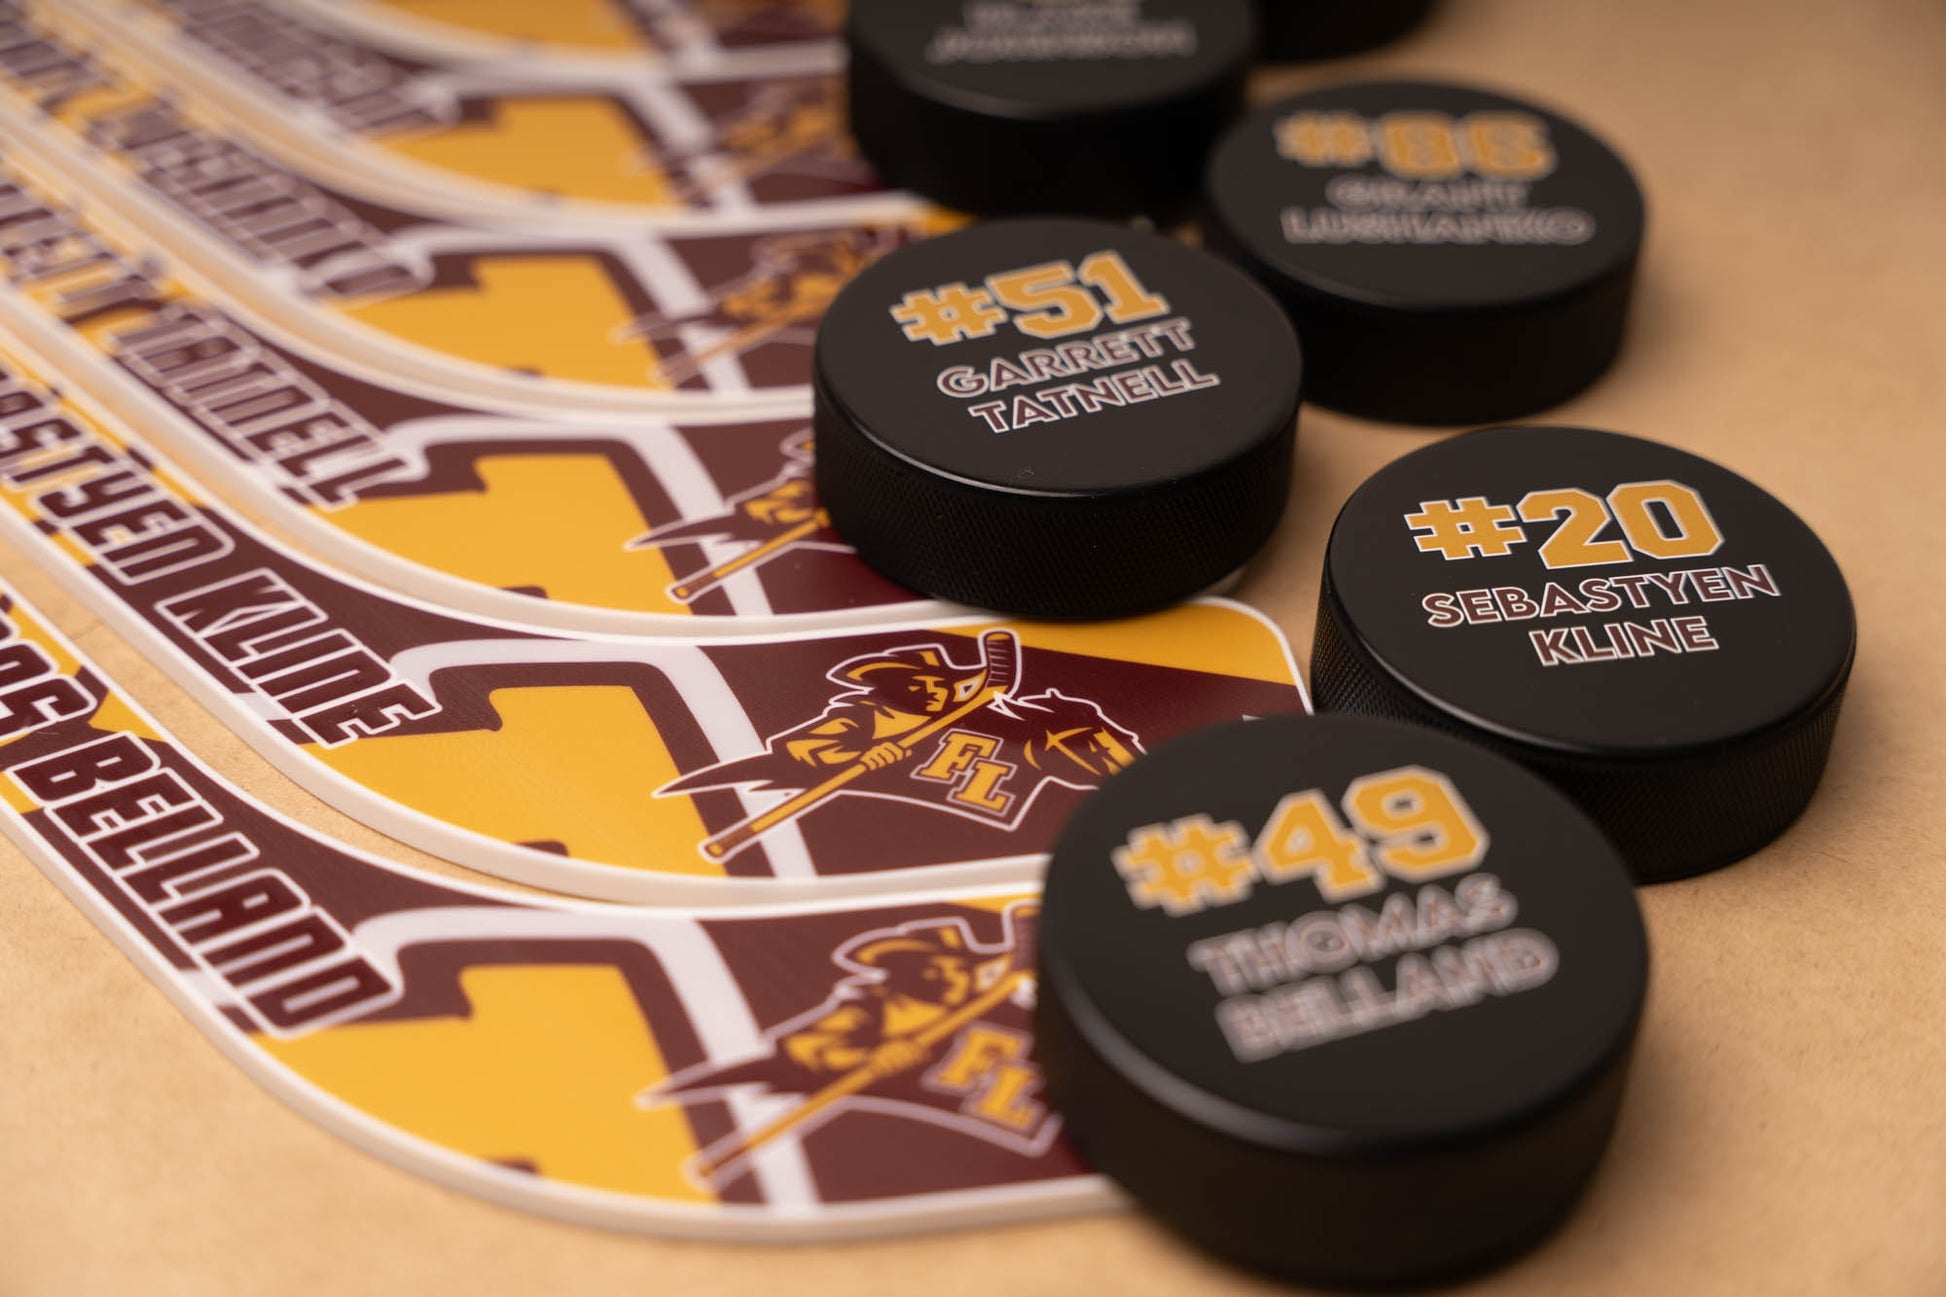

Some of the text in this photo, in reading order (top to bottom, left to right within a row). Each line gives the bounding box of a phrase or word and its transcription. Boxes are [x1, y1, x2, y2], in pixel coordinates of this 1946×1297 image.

[889, 250, 1171, 346] #51
[936, 317, 1195, 398] GARRETT
[968, 358, 1221, 433] TATNELL
[1404, 479, 1724, 569] #20
[1422, 564, 1781, 627] SEBASTYEN
[1529, 616, 1719, 666] KLINE
[153, 568, 442, 749] KLINE
[911, 728, 1015, 816] FL
[3, 730, 405, 1039] BELLAND
[1112, 765, 1491, 918] #49
[1188, 873, 1518, 997] THOMAS
[1213, 928, 1560, 1064] BELLAND
